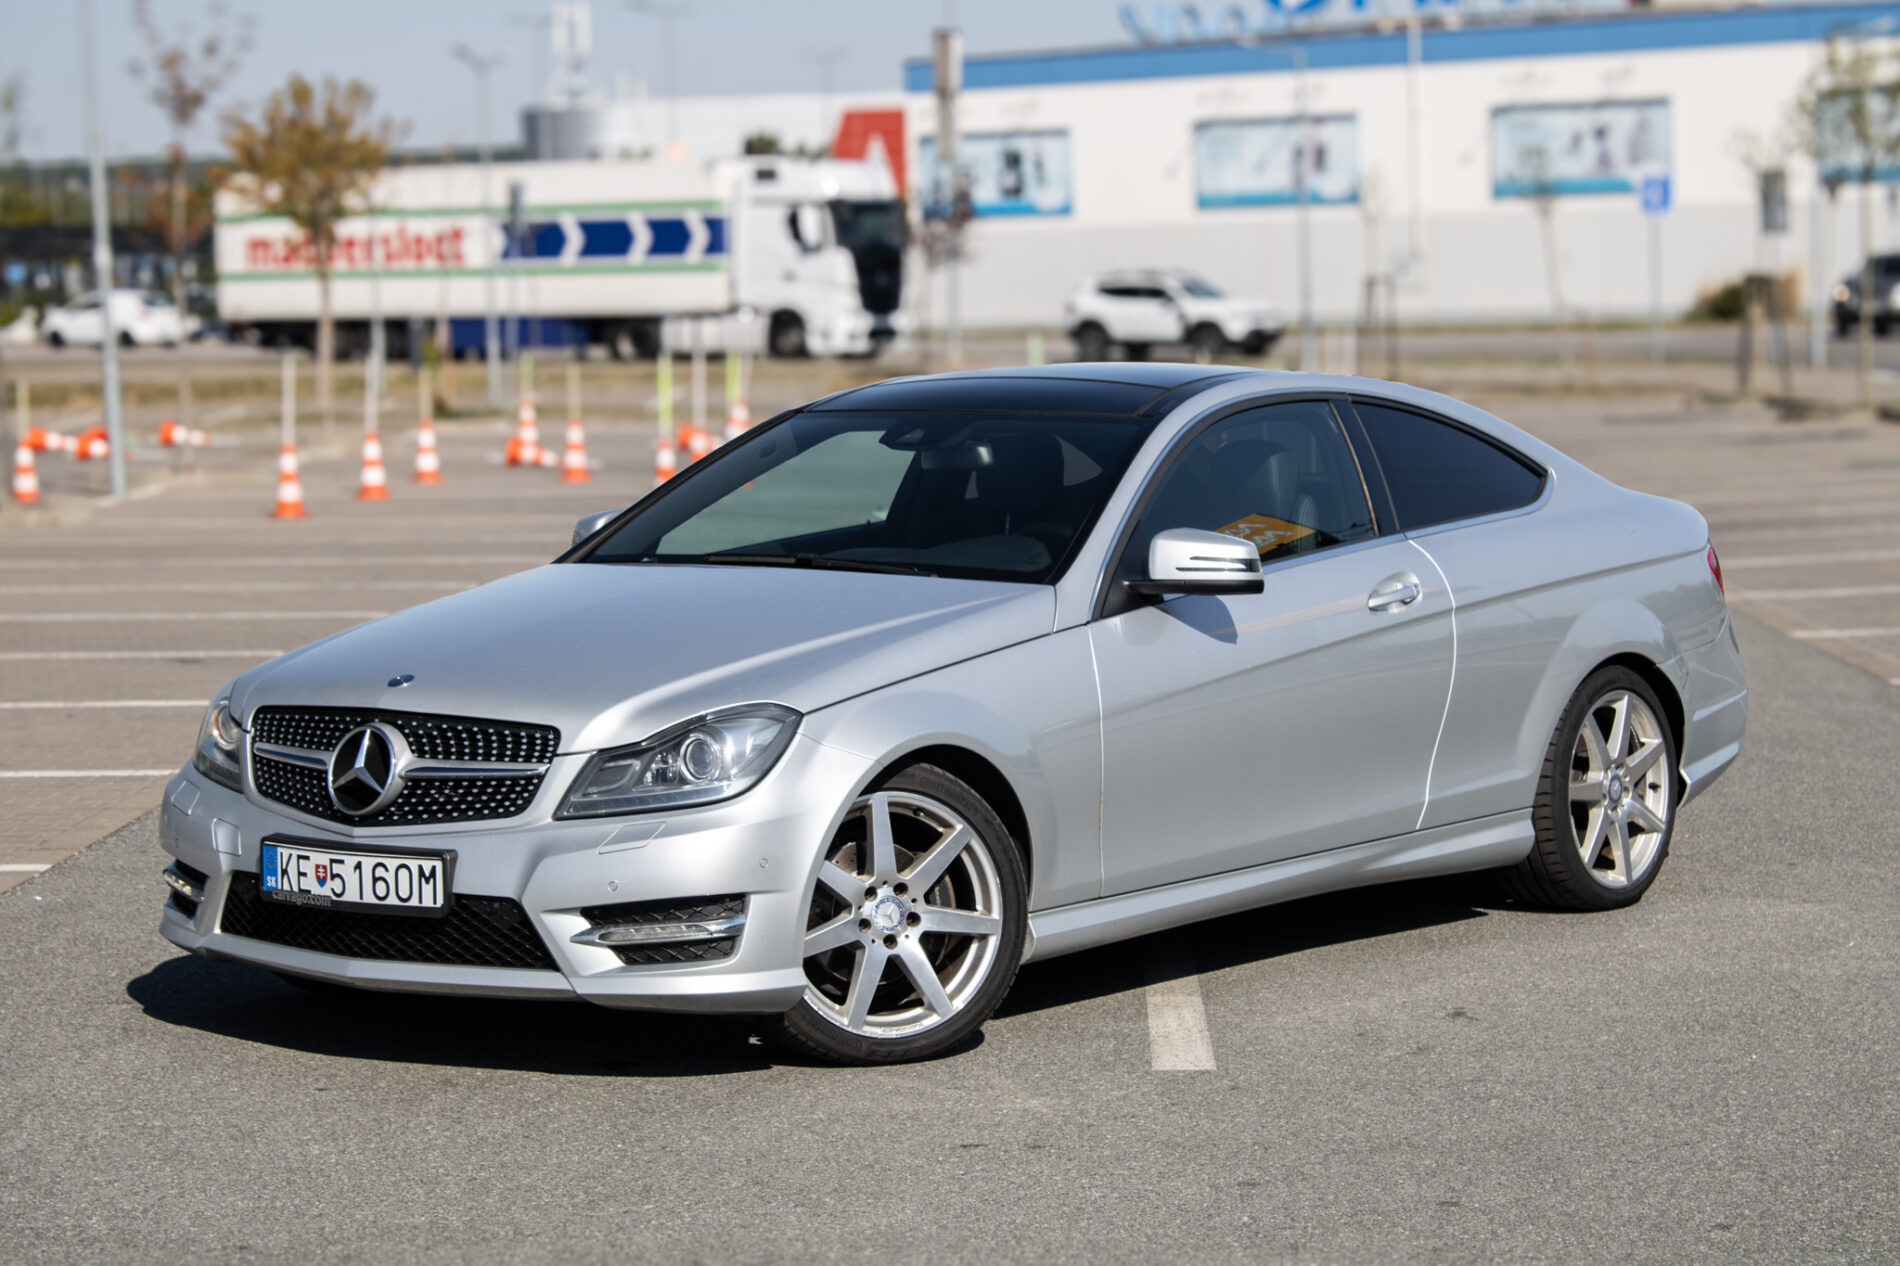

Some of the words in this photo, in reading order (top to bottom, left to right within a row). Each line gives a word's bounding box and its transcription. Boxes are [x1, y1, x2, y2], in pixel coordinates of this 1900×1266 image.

[266, 875, 277, 888] SK
[280, 851, 312, 895] KE
[329, 858, 438, 905] 5160M
[272, 889, 332, 906] carvago.com
